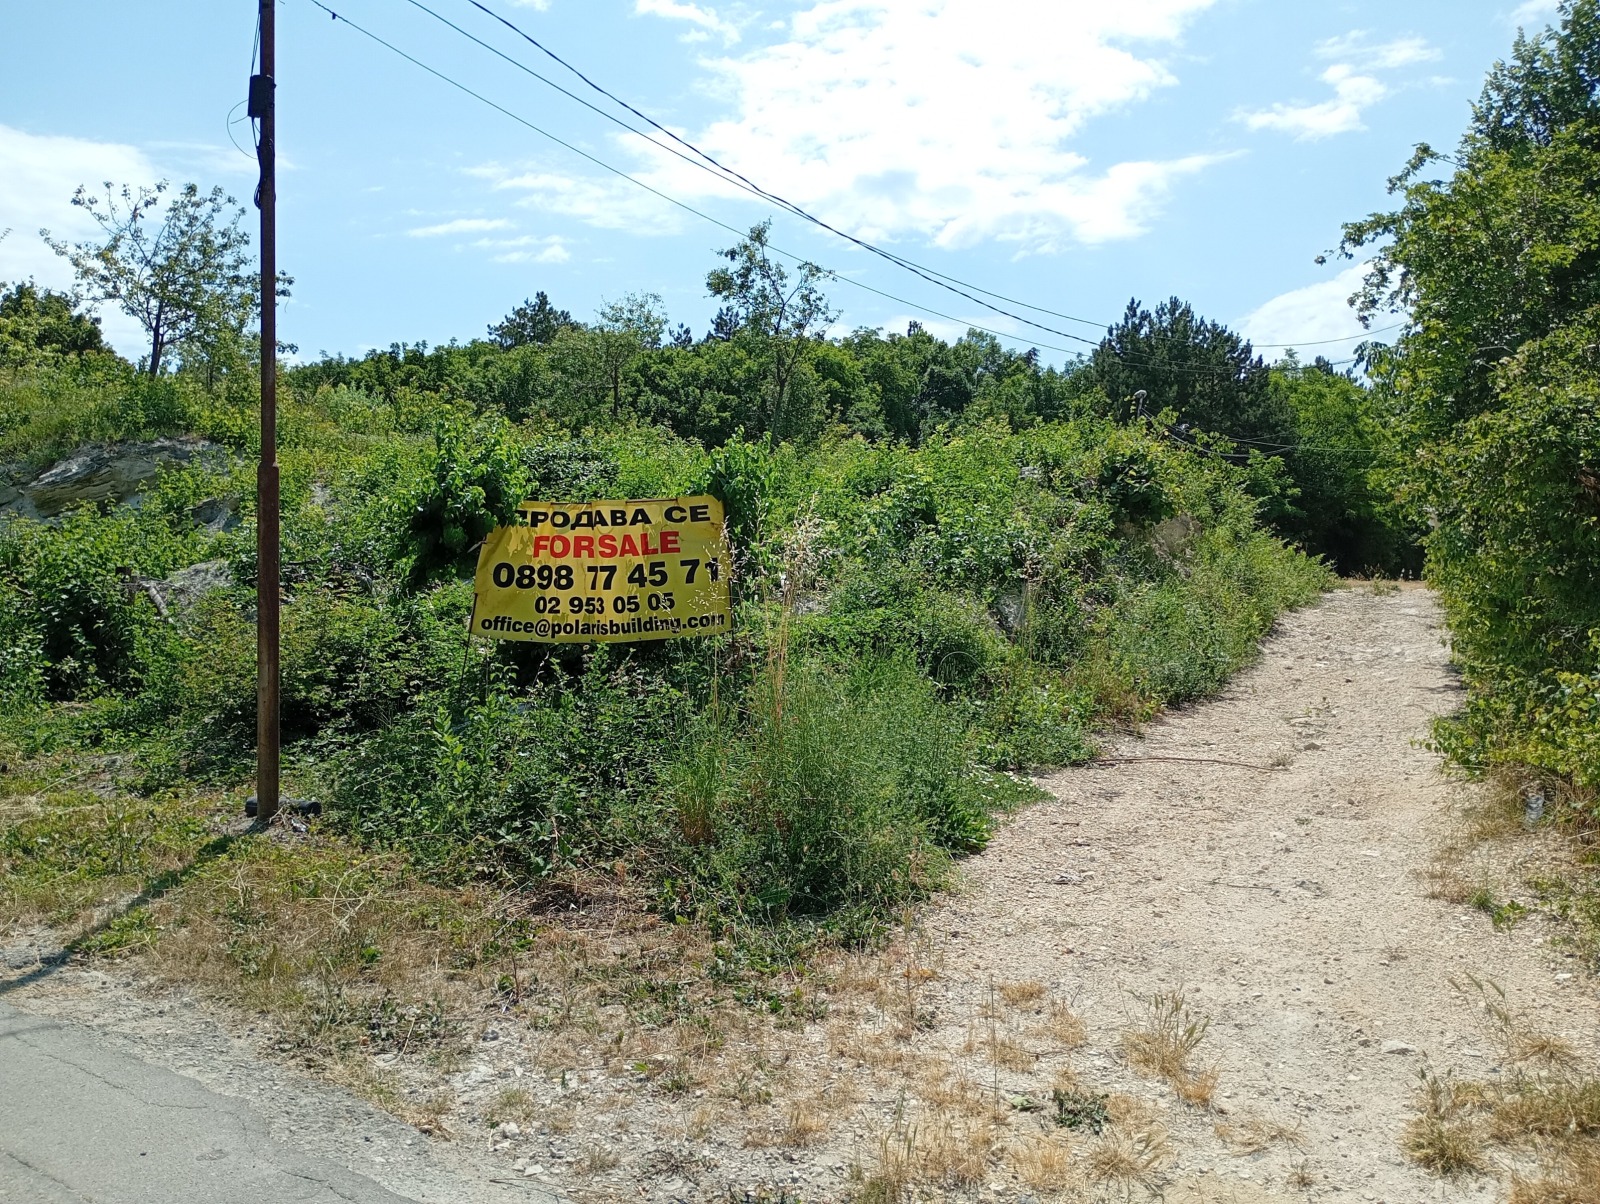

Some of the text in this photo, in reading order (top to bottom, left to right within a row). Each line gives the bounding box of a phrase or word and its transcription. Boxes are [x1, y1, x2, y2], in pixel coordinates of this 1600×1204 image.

[664, 505, 711, 522] СЕ
[492, 557, 719, 590] 0898 77 45 71
[534, 592, 676, 615] 02 953 05 05
[480, 613, 725, 638] office@polarisbuilding.com
